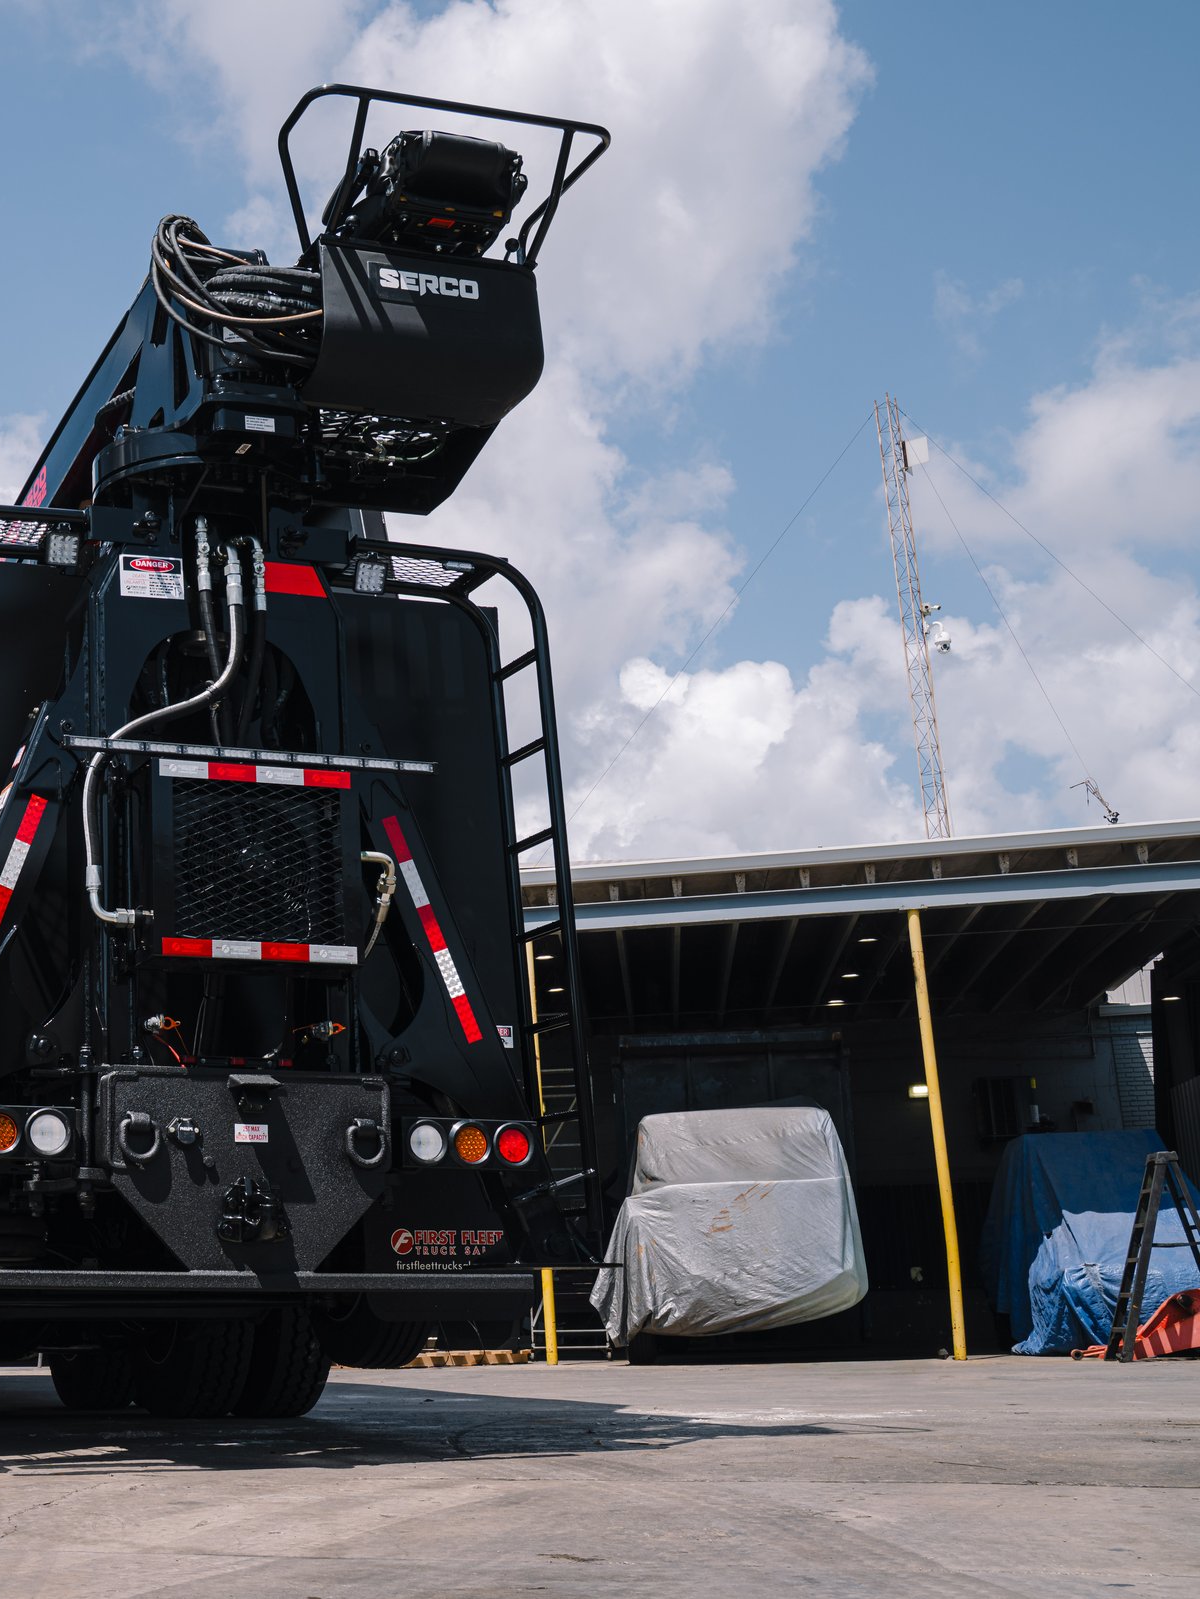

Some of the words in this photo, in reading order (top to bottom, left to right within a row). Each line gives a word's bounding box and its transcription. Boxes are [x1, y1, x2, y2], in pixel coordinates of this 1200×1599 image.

[379, 267, 480, 300] SERCO
[135, 560, 169, 568] DANGER
[414, 1229, 457, 1246] FIRST
[415, 1246, 457, 1256] TRUCK
